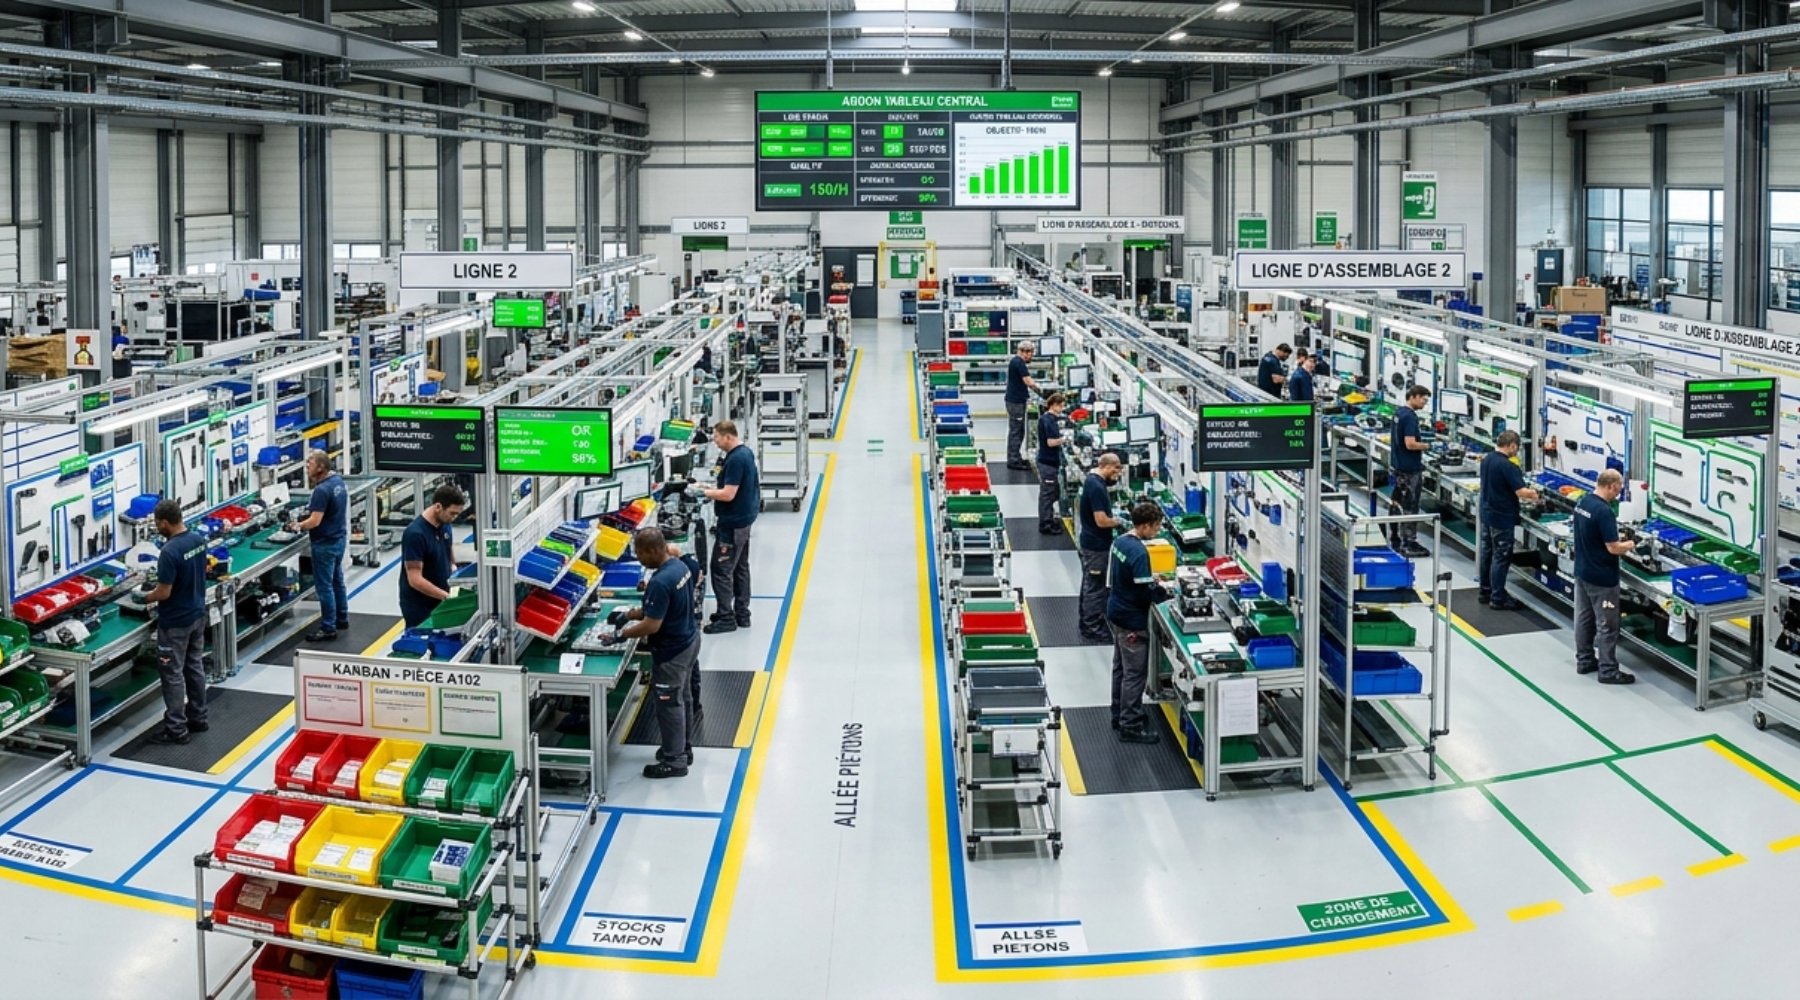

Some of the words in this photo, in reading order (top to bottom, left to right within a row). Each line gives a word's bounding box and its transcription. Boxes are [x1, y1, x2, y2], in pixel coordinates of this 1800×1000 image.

[936, 96, 988, 106] CENTRAL
[810, 183, 849, 196] 150/H
[453, 263, 503, 279] LIGNE
[508, 263, 517, 279] 2
[1252, 263, 1303, 278] LIGNE
[1308, 262, 1437, 278] D'ASSEMBLAGE
[1442, 263, 1451, 278] 2
[333, 663, 391, 680] KANBAN
[447, 673, 481, 687] A102
[832, 780, 859, 828] ALLÉE
[1368, 896, 1394, 907] DE
[596, 920, 666, 934] STOCKS
[592, 932, 664, 946] TAMPON
[992, 941, 1070, 954] PIETONS
